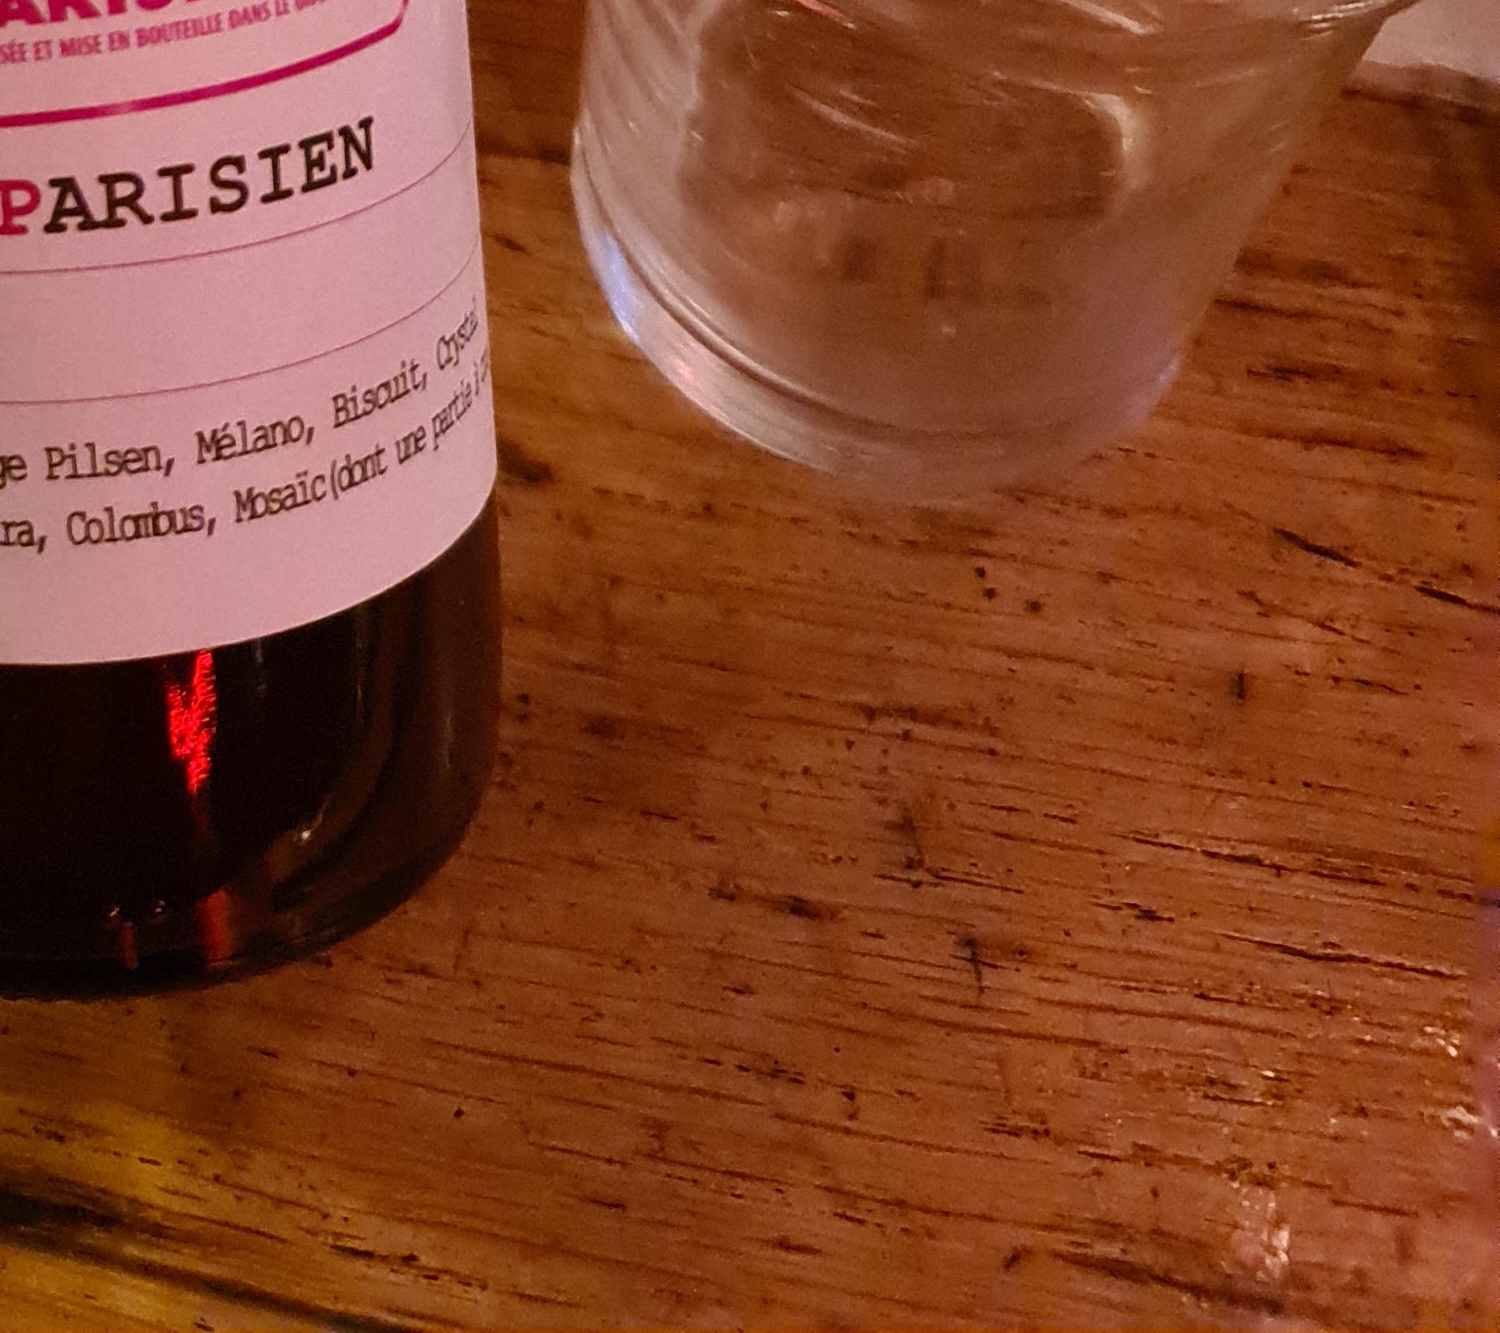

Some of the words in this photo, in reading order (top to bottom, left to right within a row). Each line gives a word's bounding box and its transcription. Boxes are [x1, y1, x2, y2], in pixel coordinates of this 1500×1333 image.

[33, 39, 53, 61] ET
[59, 34, 101, 58] MISE
[108, 30, 130, 52] EN
[135, 12, 222, 48] BOUTEILLE
[228, 1, 272, 29] DANS
[45, 443, 176, 480] Pilsen,
[196, 415, 316, 465] Mélano,
[332, 358, 428, 430] Biscuit,
[67, 502, 218, 546] Colombus,
[395, 424, 426, 465] une
[431, 379, 473, 451] partie
